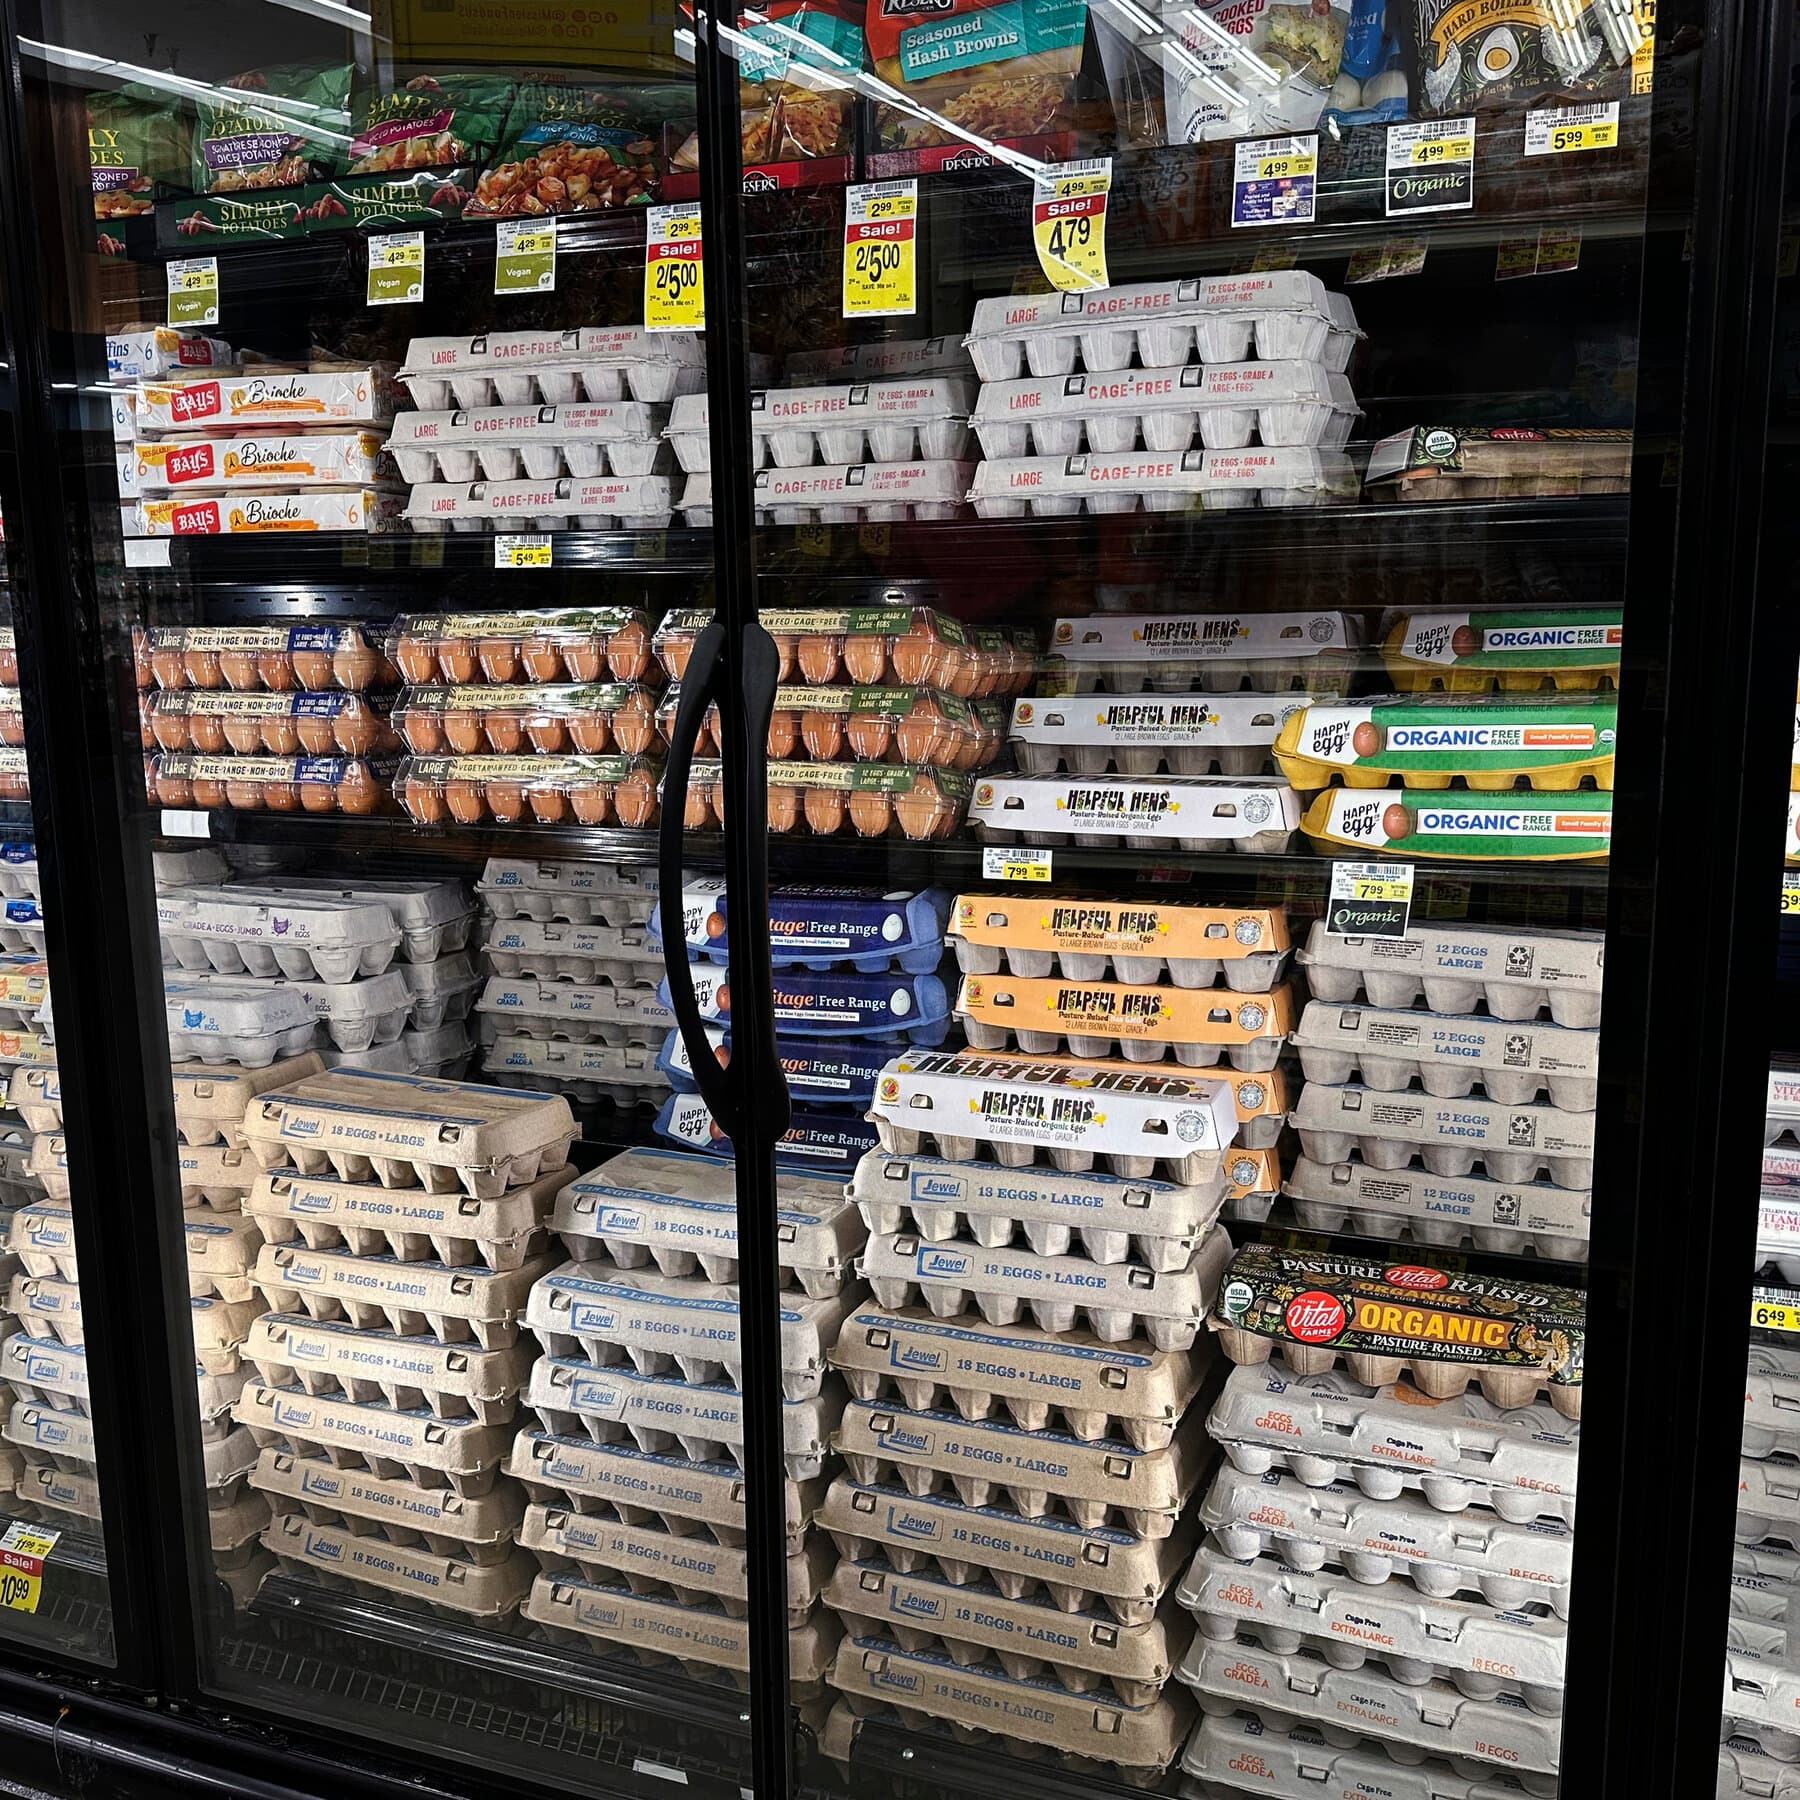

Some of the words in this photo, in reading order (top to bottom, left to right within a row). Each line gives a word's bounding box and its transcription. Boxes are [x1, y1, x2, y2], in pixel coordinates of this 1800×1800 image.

[906, 17, 983, 48] Seasoned
[1442, 8, 1475, 40] HARD
[907, 43, 951, 68] Hash
[954, 30, 1019, 57] Browns
[1393, 172, 1465, 200] Organic
[1048, 198, 1091, 216] Sale!
[859, 224, 900, 237] Sale!
[659, 242, 697, 256] Sale!
[506, 268, 531, 277] Vegan
[377, 279, 400, 289] Vegan
[1207, 285, 1215, 294] 12
[1217, 283, 1237, 294] EGGS
[1241, 281, 1263, 292] GRADE
[1266, 280, 1273, 290] A
[176, 303, 199, 312] Vegan
[1005, 307, 1038, 324] LARGE
[1087, 293, 1171, 315] CAGE-FREE
[432, 350, 457, 364] LARGE
[494, 341, 560, 358] CAGE-FREE
[1010, 392, 1041, 410] LARGE
[1088, 379, 1172, 399] CAGE-FREE
[773, 398, 846, 417] CAGE-FREE
[414, 424, 438, 438] LARGE
[474, 416, 537, 432] CAGE-FREE
[171, 453, 209, 474] BAYS
[241, 443, 297, 466] Brioche
[1010, 471, 1042, 487] LARGE
[1090, 463, 1174, 481] CAGE-FREE
[432, 498, 457, 511] LARGE
[493, 493, 554, 508] CAGE-FREE
[177, 510, 214, 533] BAYS
[246, 500, 301, 524] Brioche
[348, 505, 358, 524] 6
[412, 619, 439, 632] LARGE
[1416, 624, 1450, 644] HAPPY
[1577, 629, 1605, 638] FREE
[1415, 638, 1446, 657] egg
[1488, 630, 1576, 646] ORGANIC
[1577, 636, 1604, 645] RANGE
[161, 698, 184, 710] LARGE
[1313, 720, 1350, 741] HAPPY
[1393, 730, 1488, 746] ORGANIC
[1491, 729, 1521, 739] FREE
[1313, 735, 1347, 756] egg
[1491, 737, 1521, 746] RANGE
[1066, 790, 1124, 811] HELPFUL
[1130, 790, 1170, 812] HENS
[1343, 802, 1380, 822] HAPPY
[1523, 815, 1552, 825] FREE
[1343, 816, 1376, 837] egg
[1423, 814, 1520, 830] ORGANIC
[1522, 823, 1552, 832] RANGE
[1051, 907, 1112, 931] HELPFUL
[1118, 910, 1159, 933] HENS
[1334, 909, 1401, 926] Organic
[215, 924, 235, 933] EGGS
[237, 926, 263, 937] JUMBO
[810, 922, 838, 933] Free
[840, 922, 879, 936] Range
[1435, 944, 1449, 953] 12
[1452, 944, 1488, 957] EGGS
[1438, 956, 1483, 969] LARGE
[819, 995, 845, 1007] Free
[848, 996, 887, 1011] Range
[1057, 988, 1116, 1014] HELPFUL
[1122, 993, 1162, 1016] HENS
[1432, 1031, 1447, 1041] 12
[1449, 1033, 1486, 1046] EGGS
[1434, 1044, 1481, 1057] LARGE
[981, 1091, 1045, 1119] HELPFUL
[1051, 1098, 1095, 1123] HENS
[291, 1118, 320, 1132] Jewel
[1040, 1119, 1068, 1131] Organic
[331, 1126, 343, 1135] 18
[345, 1128, 377, 1140] EGGS
[385, 1133, 425, 1147] LARGE
[923, 1179, 961, 1195] Jewel
[978, 1186, 993, 1198] 18
[997, 1188, 1038, 1203] EGGS
[1051, 1193, 1104, 1208] LARGE
[930, 1254, 967, 1270] Jewel
[1282, 1259, 1382, 1281] PASTURE
[983, 1264, 999, 1275] 18
[1002, 1266, 1043, 1281] EGGS
[1054, 1273, 1107, 1289] LARGE
[1388, 1266, 1440, 1285] Vital
[1230, 1288, 1249, 1297] USDA
[1448, 1279, 1549, 1307] RAISED
[581, 1310, 614, 1328] Jewel
[1290, 1305, 1340, 1329] Vital
[1359, 1303, 1505, 1346] ORGANIC
[628, 1320, 642, 1330] 18
[645, 1321, 680, 1335] EGGS
[690, 1326, 736, 1342] LARGE
[1300, 1328, 1334, 1338] FARMS
[1371, 1335, 1483, 1357] PASTURE-RAISED
[1311, 1392, 1349, 1402] MAINLAND
[1255, 1417, 1292, 1434] GRADE
[1293, 1426, 1302, 1436] A
[1267, 1411, 1293, 1423] EGGS
[1372, 1444, 1403, 1461] EXTRA
[1403, 1450, 1436, 1467] LARGE
[1515, 1475, 1526, 1487] 18
[1528, 1477, 1561, 1495] EGGS
[4, 1553, 33, 1570] Sale!
[671, 1555, 716, 1575] LARGE
[904, 1593, 939, 1612] Jewel
[955, 1608, 971, 1620] 18
[973, 1613, 1013, 1632] EGGS
[1026, 1626, 1078, 1649] LARGE
[1331, 1621, 1363, 1638] EXTRA
[1364, 1629, 1394, 1646] LARGE
